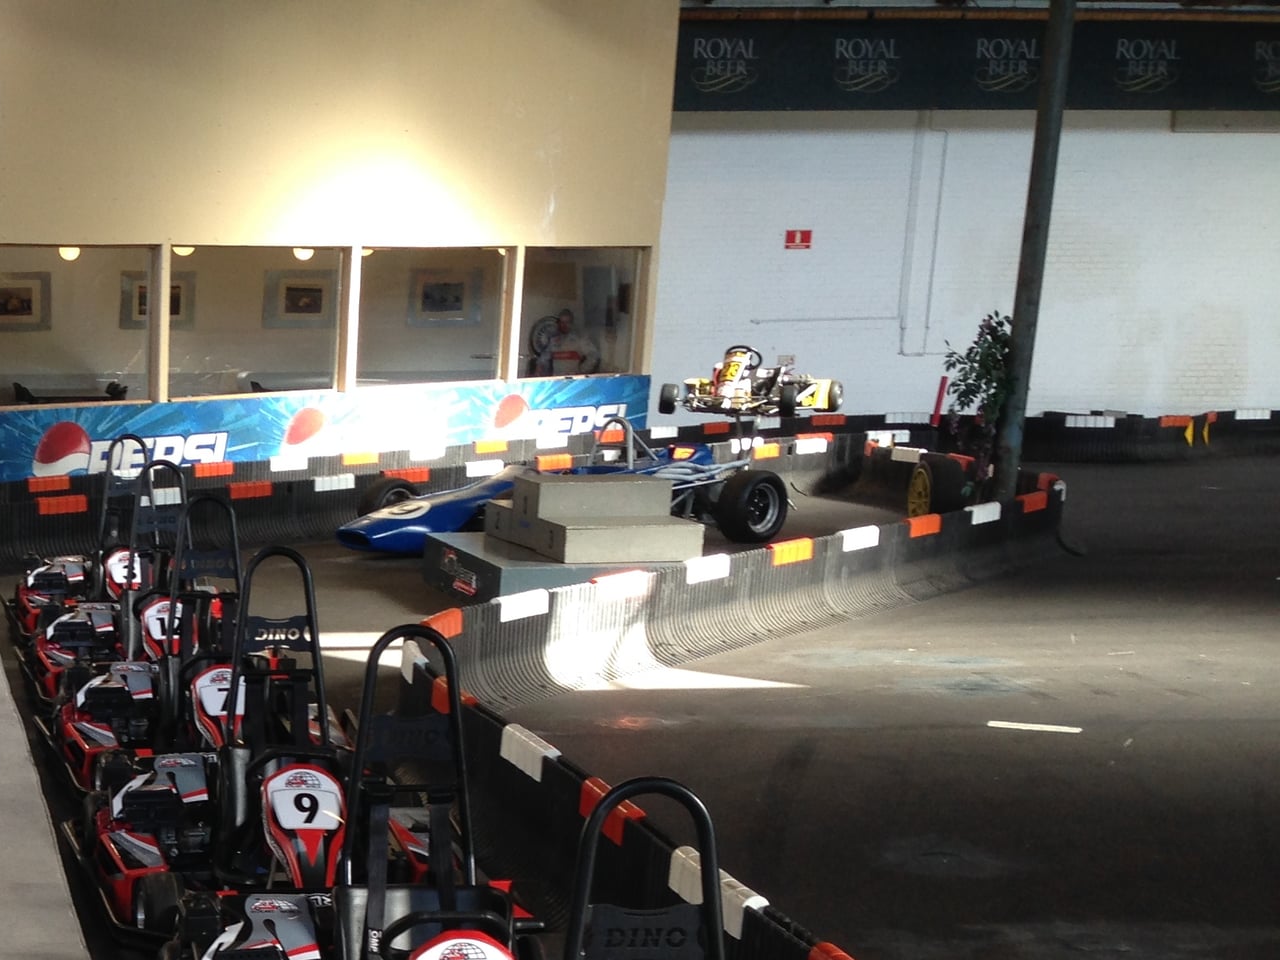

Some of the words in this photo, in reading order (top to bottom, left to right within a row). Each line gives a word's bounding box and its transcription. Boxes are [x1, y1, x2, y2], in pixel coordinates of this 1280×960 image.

[693, 38, 760, 60] ROYAL
[834, 38, 901, 60] ROYAL
[975, 38, 1040, 60] ROYAL
[1115, 38, 1181, 60] ROYAL
[706, 60, 748, 76] BEER
[848, 60, 889, 76] BEER
[988, 60, 1028, 76] BEER
[1128, 60, 1168, 76] BEER
[527, 404, 627, 435] PEPSI
[87, 432, 228, 480] PEPSI
[255, 628, 300, 641] DINO
[293, 792, 319, 824] 9
[370, 930, 380, 953] OMP
[605, 927, 687, 948] DINO
